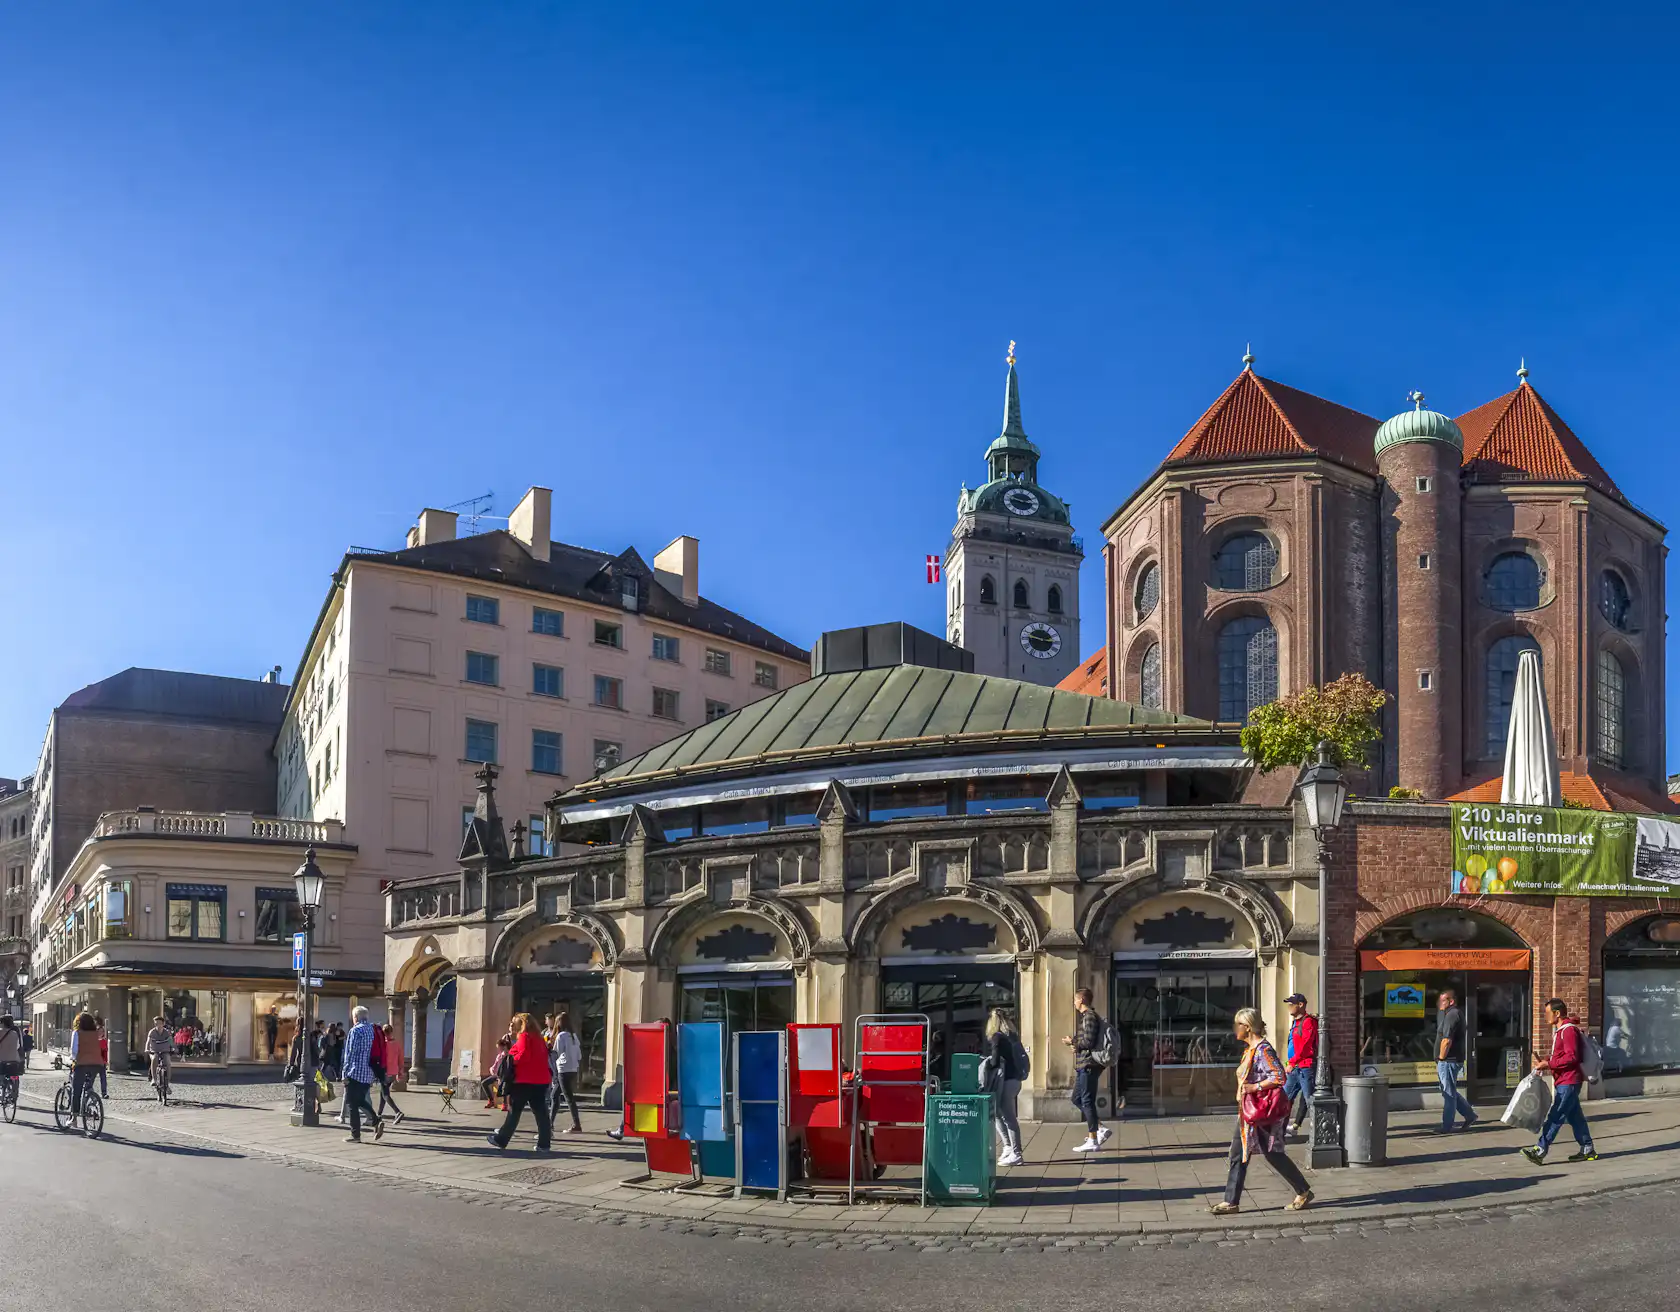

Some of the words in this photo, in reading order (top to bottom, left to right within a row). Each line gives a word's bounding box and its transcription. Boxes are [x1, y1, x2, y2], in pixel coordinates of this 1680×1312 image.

[1460, 807, 1491, 823] 210
[1495, 808, 1543, 825] Jahre
[1460, 825, 1595, 846] Viktualienmarkt
[1482, 844, 1506, 852] vielen
[1507, 844, 1535, 853] bunten
[1535, 844, 1595, 855] Überraschungen
[1512, 880, 1542, 889] Weitere
[1543, 881, 1564, 889] Infos:
